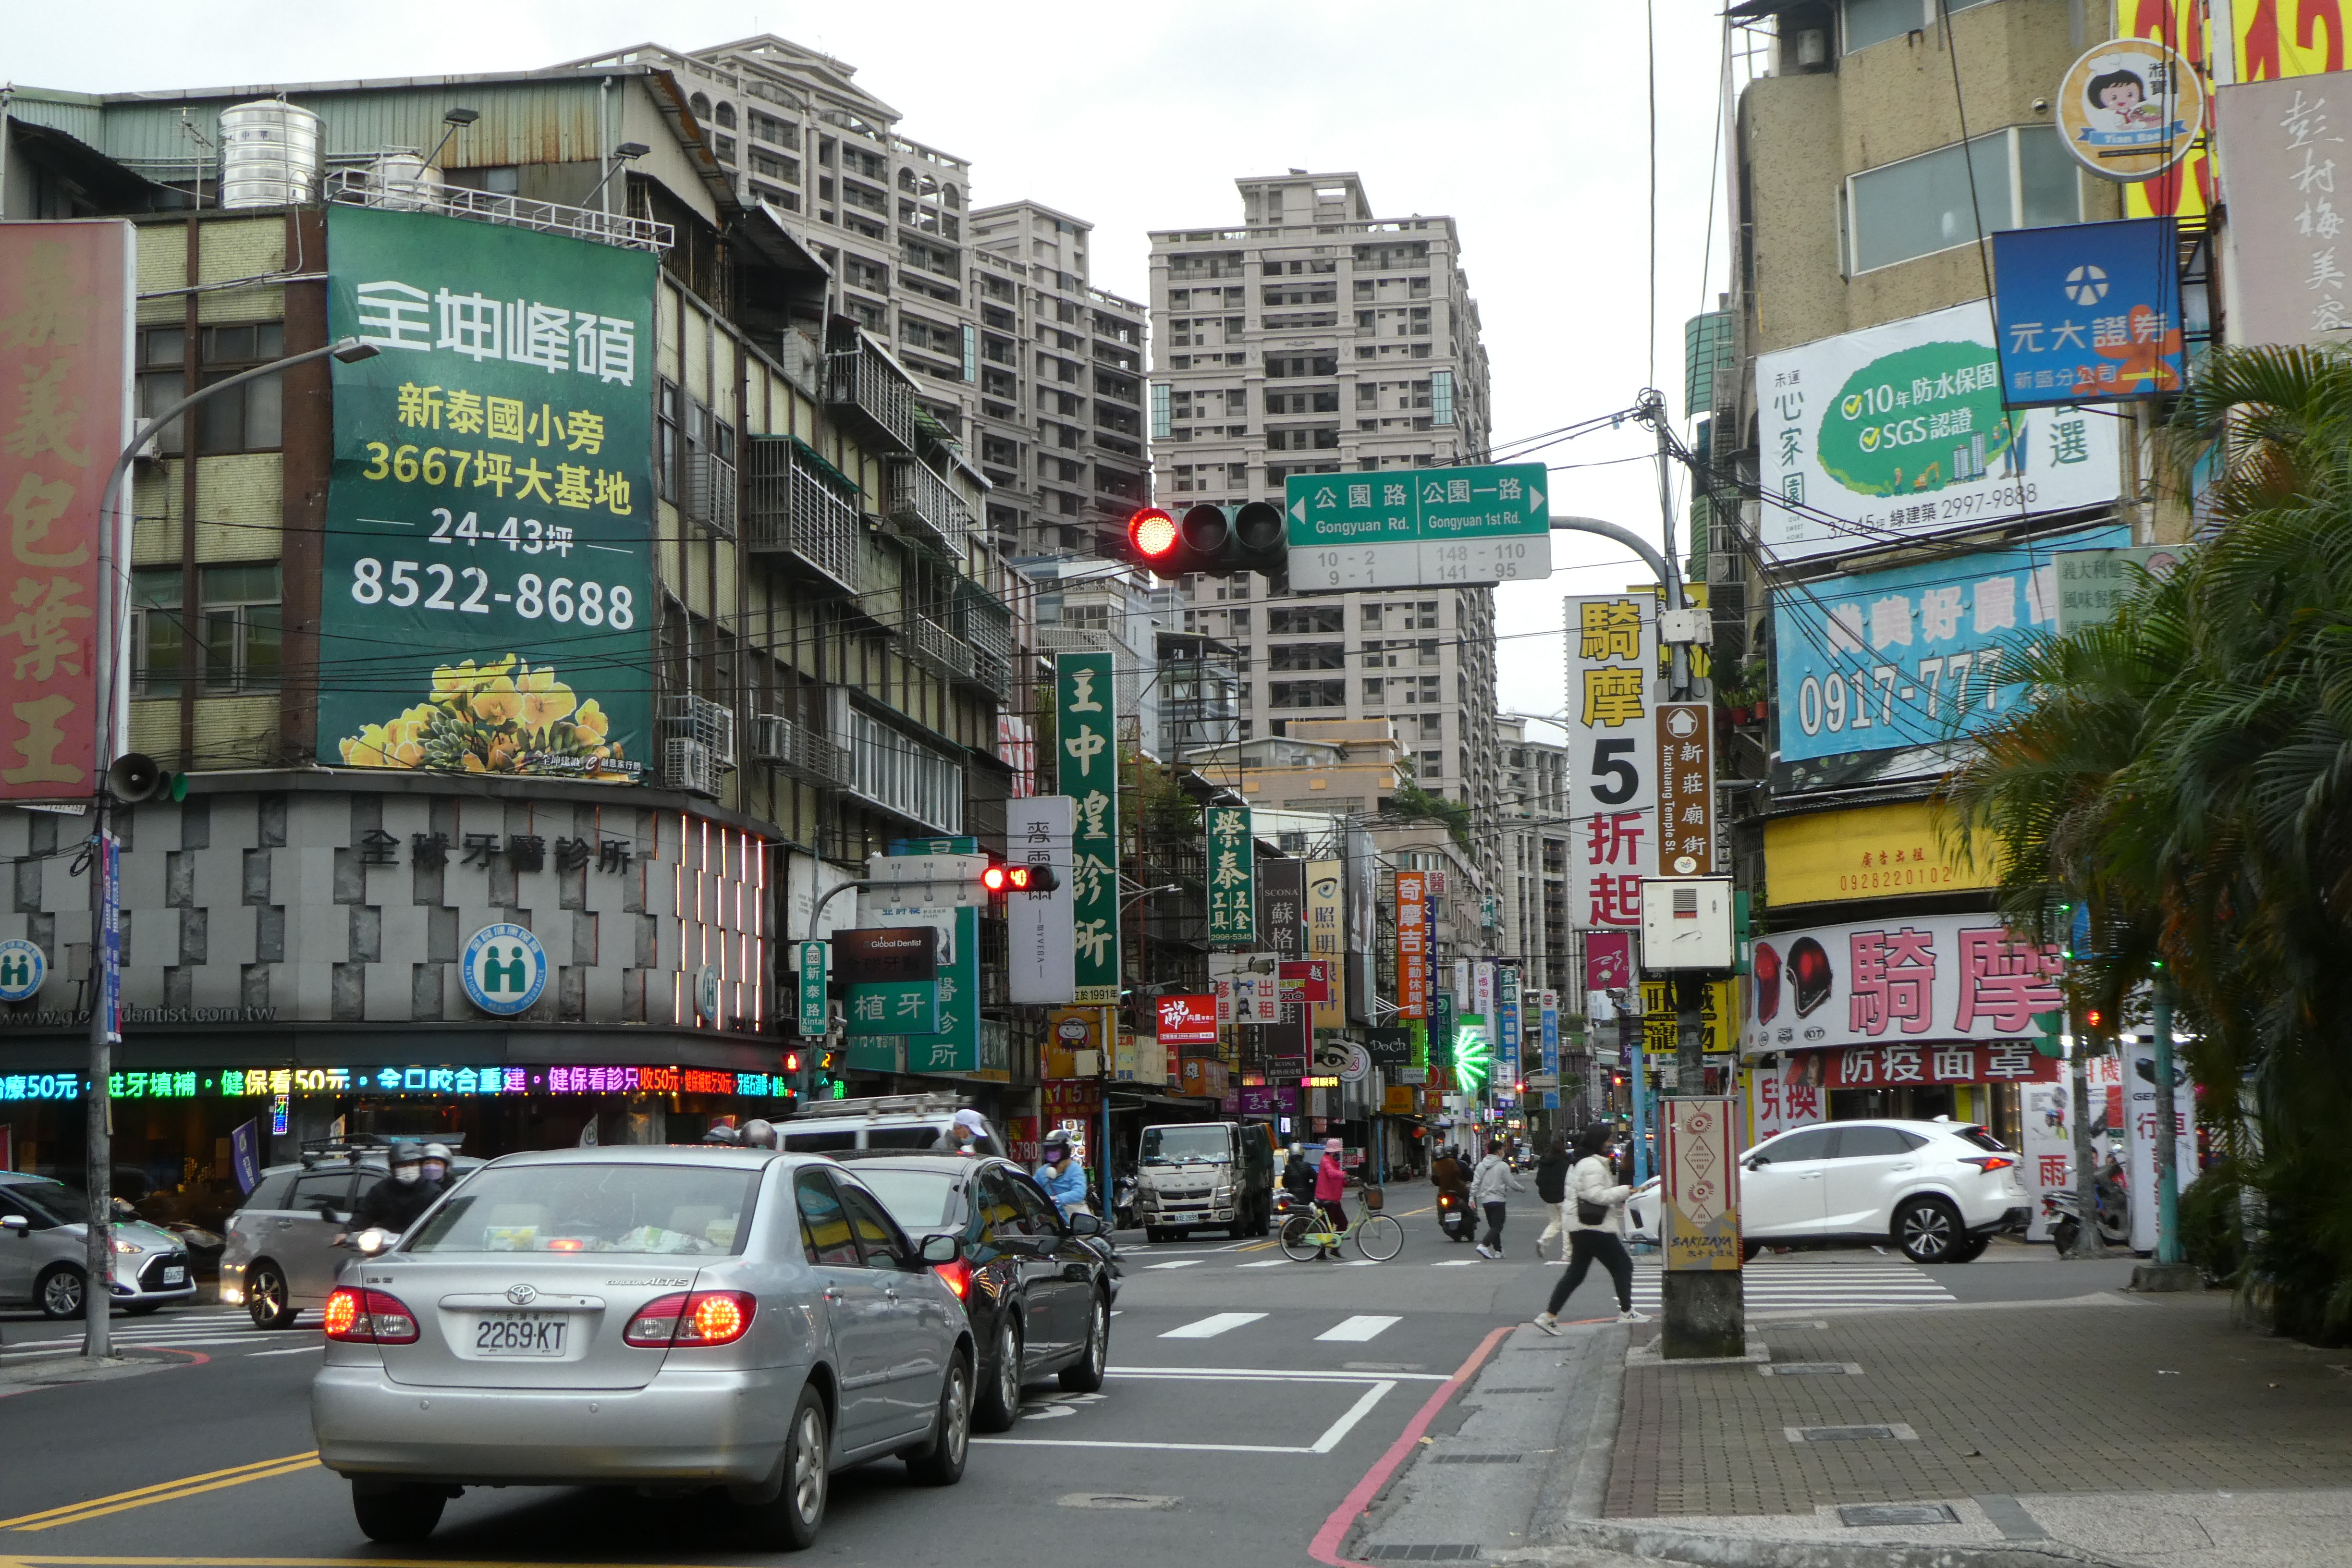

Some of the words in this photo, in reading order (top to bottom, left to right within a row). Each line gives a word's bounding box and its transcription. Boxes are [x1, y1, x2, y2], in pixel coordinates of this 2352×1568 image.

[357, 280, 634, 387] 全坤峰碩
[2010, 313, 2168, 354] 元大證券
[1863, 361, 1997, 416] 10年防水保固
[398, 382, 604, 455] 新泰國小旁
[1883, 406, 1973, 450] SGS認證
[1774, 391, 1805, 509] 心家園
[362, 442, 632, 515] 3667坪大基地
[1314, 483, 1407, 509] 公園路
[1422, 478, 1522, 504] 公園一路
[1889, 503, 1937, 529] 綠建築
[1941, 483, 2038, 520] 2997-9888
[428, 507, 574, 557] 24-43坪
[1316, 520, 1381, 536] Gongyuan
[1388, 517, 1409, 531] Rd.
[1428, 514, 1482, 531] Gongyuan
[1486, 513, 1501, 526] 1st
[1503, 511, 1521, 525] Rd.
[1786, 524, 1803, 532] SWEET
[1786, 533, 1803, 541] HOME
[1826, 514, 1886, 541] 37-45坪
[1317, 551, 1338, 567] 10
[1364, 550, 1375, 565] 2
[1436, 546, 1468, 563] 148
[1494, 543, 1526, 559] 110
[1436, 564, 1467, 580] 141
[1494, 563, 1517, 578] 95
[351, 557, 634, 630] 8522-8688
[1329, 570, 1339, 586] 9
[1366, 568, 1374, 584] 1
[1579, 599, 1645, 927] 騎摩5折起
[1662, 745, 1674, 799] Xinzhuang
[1065, 667, 1115, 967] 王中煌診所
[1679, 741, 1706, 856] 新莊廟街
[1663, 801, 1676, 838] Temple
[359, 829, 632, 877] 全球牙醫診所
[1212, 811, 1249, 889] 榮泰
[1665, 840, 1676, 854] St.
[1861, 847, 1924, 869] 廣告出租
[1010, 869, 1028, 887] 40
[1424, 872, 1445, 893] 醫
[1840, 866, 1951, 891] 0928220102
[1210, 892, 1229, 931] 工具
[1233, 891, 1251, 930] 五金
[1399, 878, 1422, 952] 奇摩吉
[871, 940, 895, 948] Global
[897, 939, 921, 947] Dentist
[1210, 933, 1252, 941] 2996-5345
[807, 952, 818, 962] 106
[466, 965, 483, 1002] NATIONAL
[521, 968, 545, 1007] INSURANCE
[806, 966, 820, 1017] 新泰路
[1258, 980, 1274, 1019] 出租
[1849, 927, 2065, 1037] 騎摩
[802, 1017, 825, 1026] Xintai
[1840, 1040, 2035, 1084] 防疫面罩
[1301, 1077, 1338, 1087] 照明眼科
[642, 1276, 689, 1287] ALTIS
